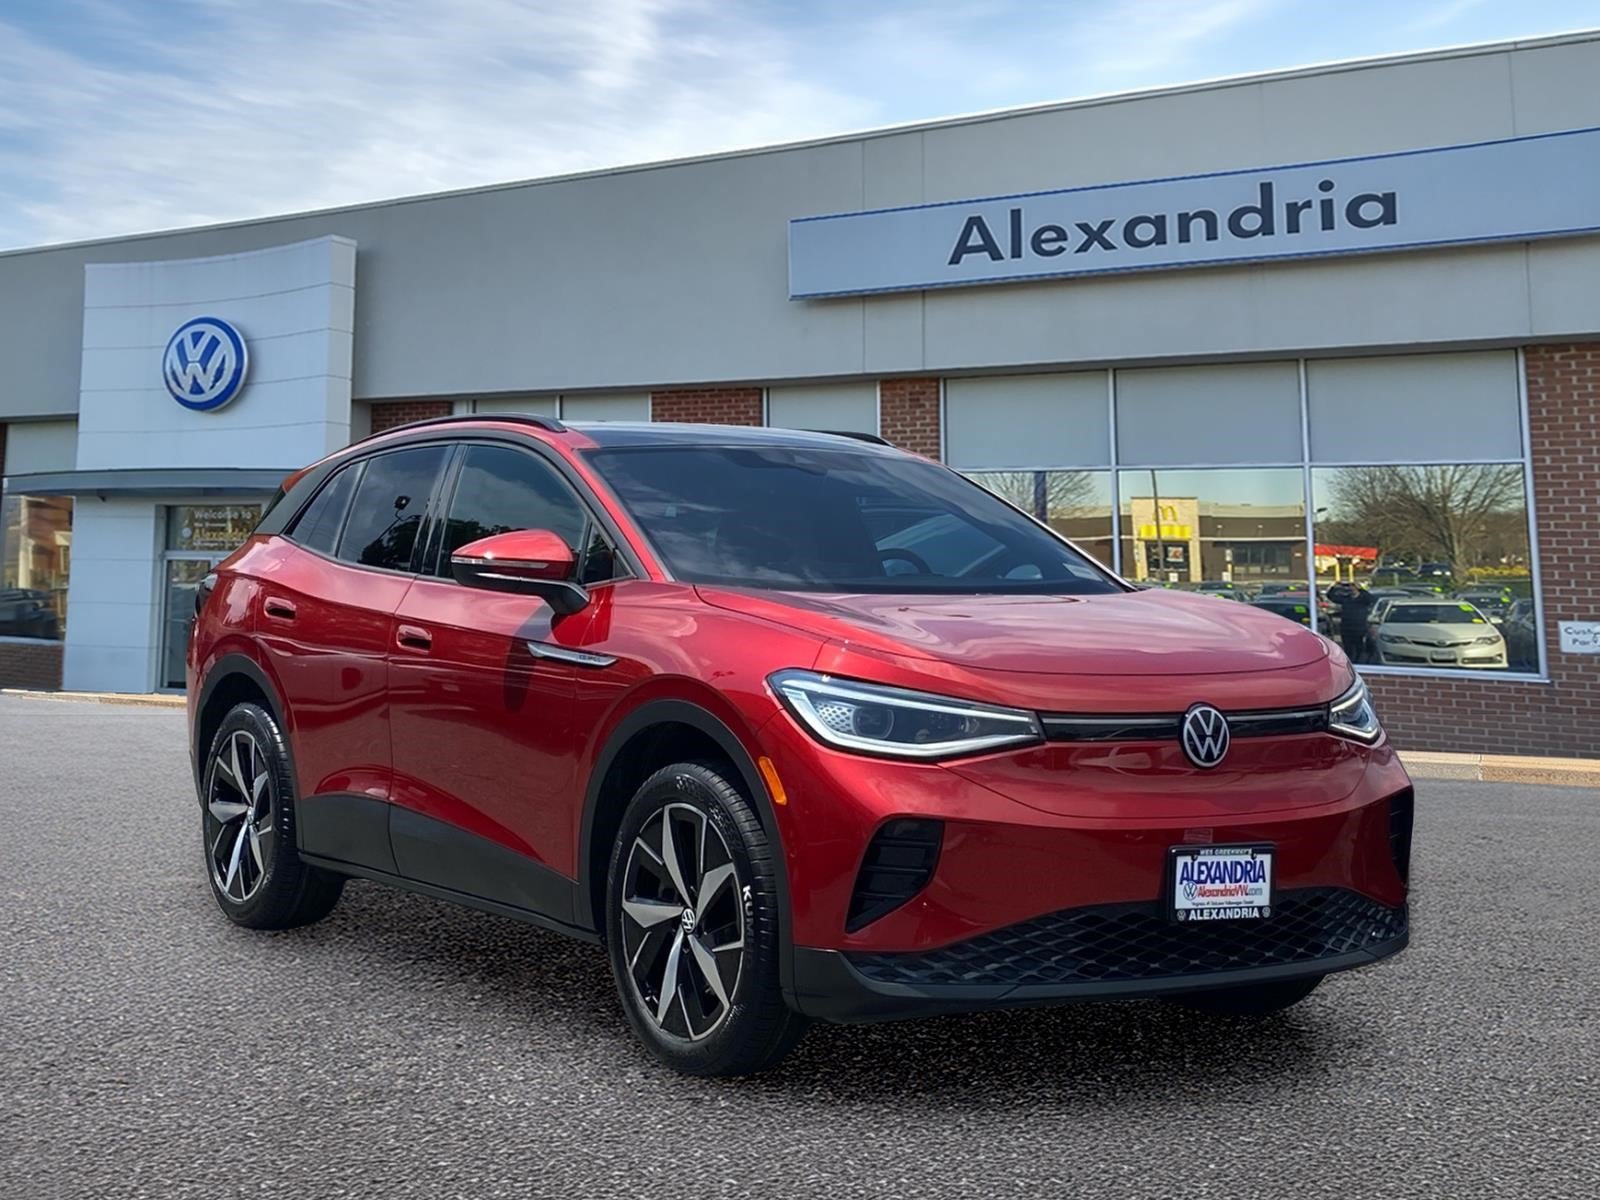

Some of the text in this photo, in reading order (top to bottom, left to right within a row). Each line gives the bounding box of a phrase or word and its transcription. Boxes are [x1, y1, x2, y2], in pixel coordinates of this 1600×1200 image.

[947, 179, 1399, 266] Alexandria
[166, 321, 241, 405] VW
[1184, 707, 1229, 766] VW
[1179, 860, 1266, 884] ALEXANDRIA
[1189, 908, 1260, 920] ALEXANDRIA
